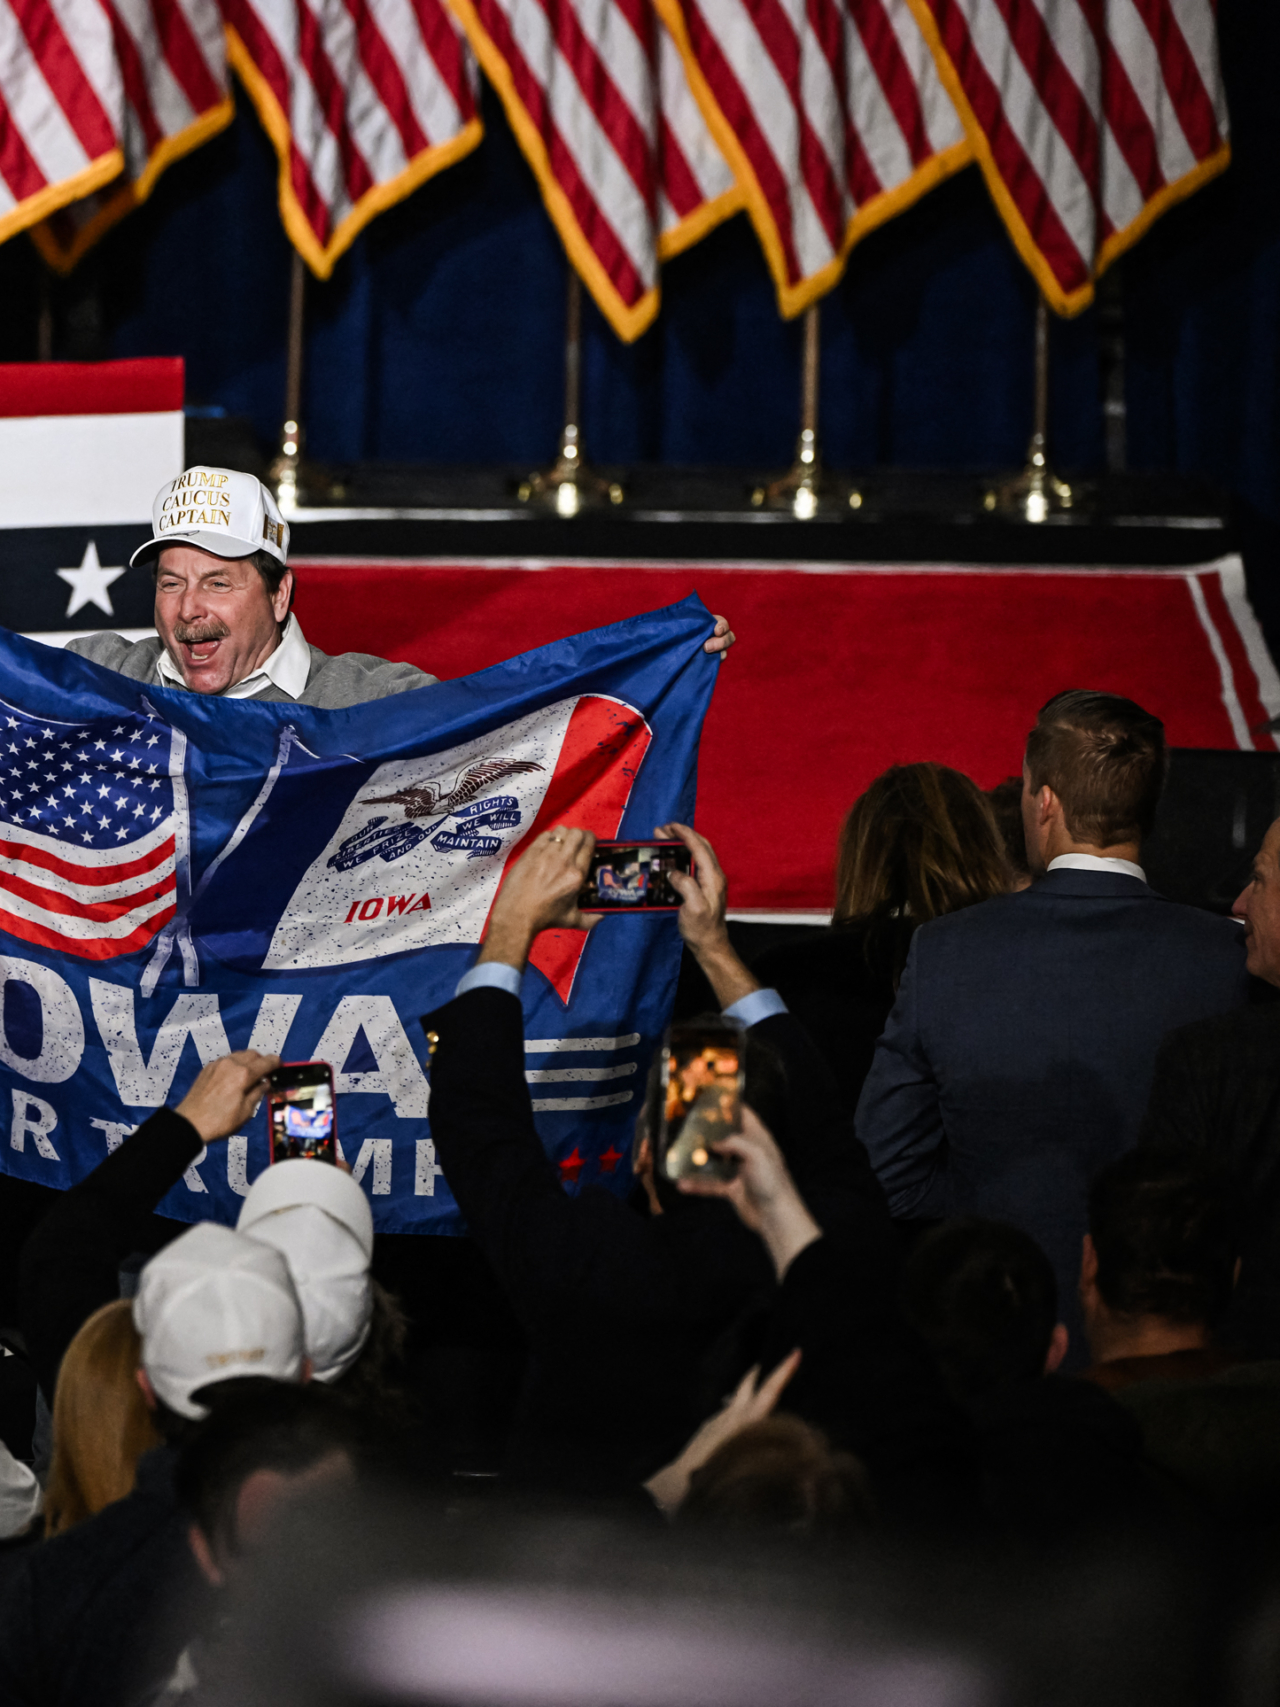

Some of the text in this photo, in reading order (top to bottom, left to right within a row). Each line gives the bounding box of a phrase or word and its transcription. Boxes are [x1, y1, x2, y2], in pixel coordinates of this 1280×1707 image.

[170, 472, 229, 493] TRUMP
[162, 490, 230, 512] CAUCUS
[159, 509, 231, 531] CAPTAIN
[470, 797, 514, 815] RIGHTS
[462, 810, 517, 831] WE WILL
[351, 825, 374, 842] OUR
[437, 835, 499, 848] MAINTAIN
[343, 830, 411, 869] WE PRIZE
[389, 843, 412, 860] AND
[344, 892, 431, 923] IOWA
